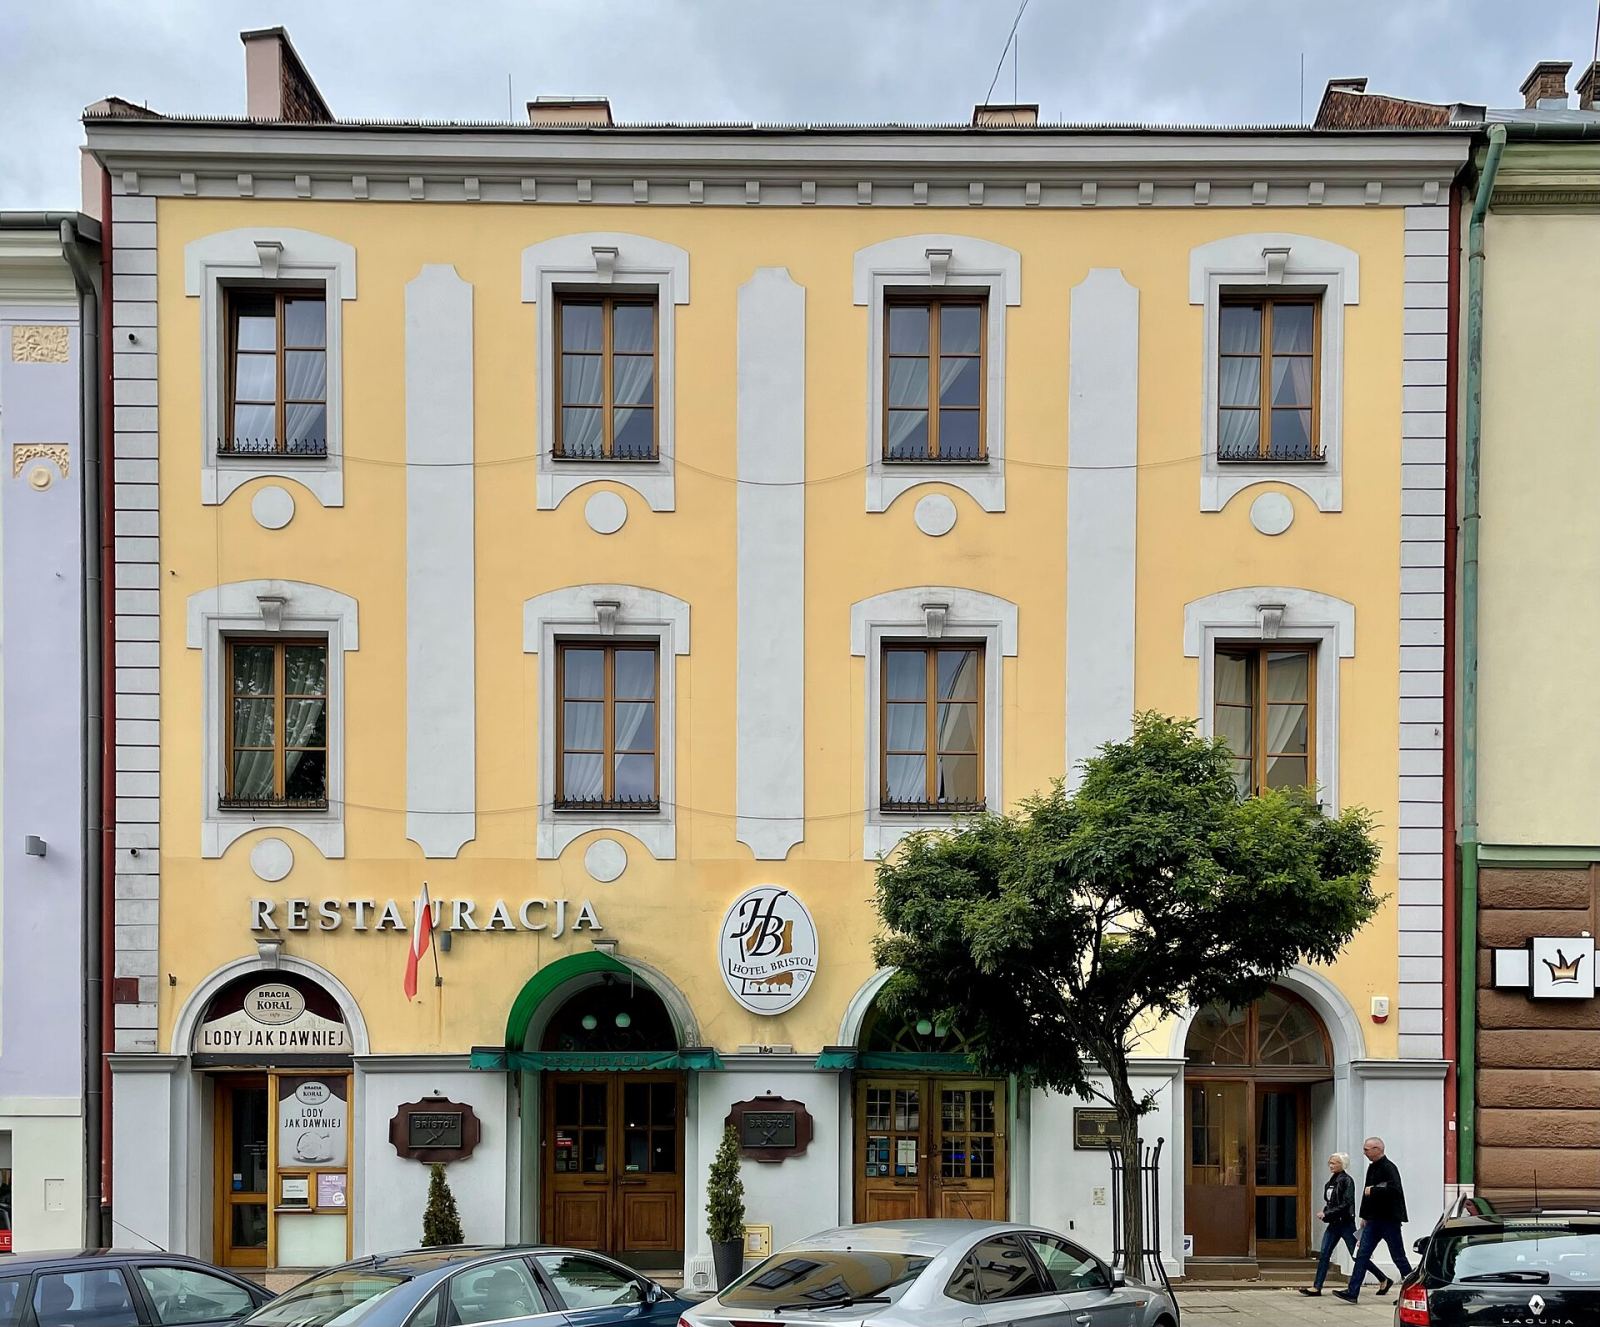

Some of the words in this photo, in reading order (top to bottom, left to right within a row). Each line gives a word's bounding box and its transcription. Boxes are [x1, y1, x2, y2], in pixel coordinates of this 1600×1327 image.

[250, 898, 602, 938] RESTAURACJA
[732, 963, 768, 976] HOTEL
[770, 956, 814, 971] BRISTOL
[256, 1000, 293, 1011] KORAL
[204, 1030, 242, 1046] LODY
[247, 1030, 275, 1046] JAK
[279, 1030, 344, 1046] DAWNIEJ
[301, 1108, 324, 1118] LODY
[284, 1118, 300, 1128] JAK
[302, 1118, 342, 1128] DAWNIEJ
[415, 1120, 457, 1129] BRISTOL
[749, 1119, 791, 1129] BRISTOL
